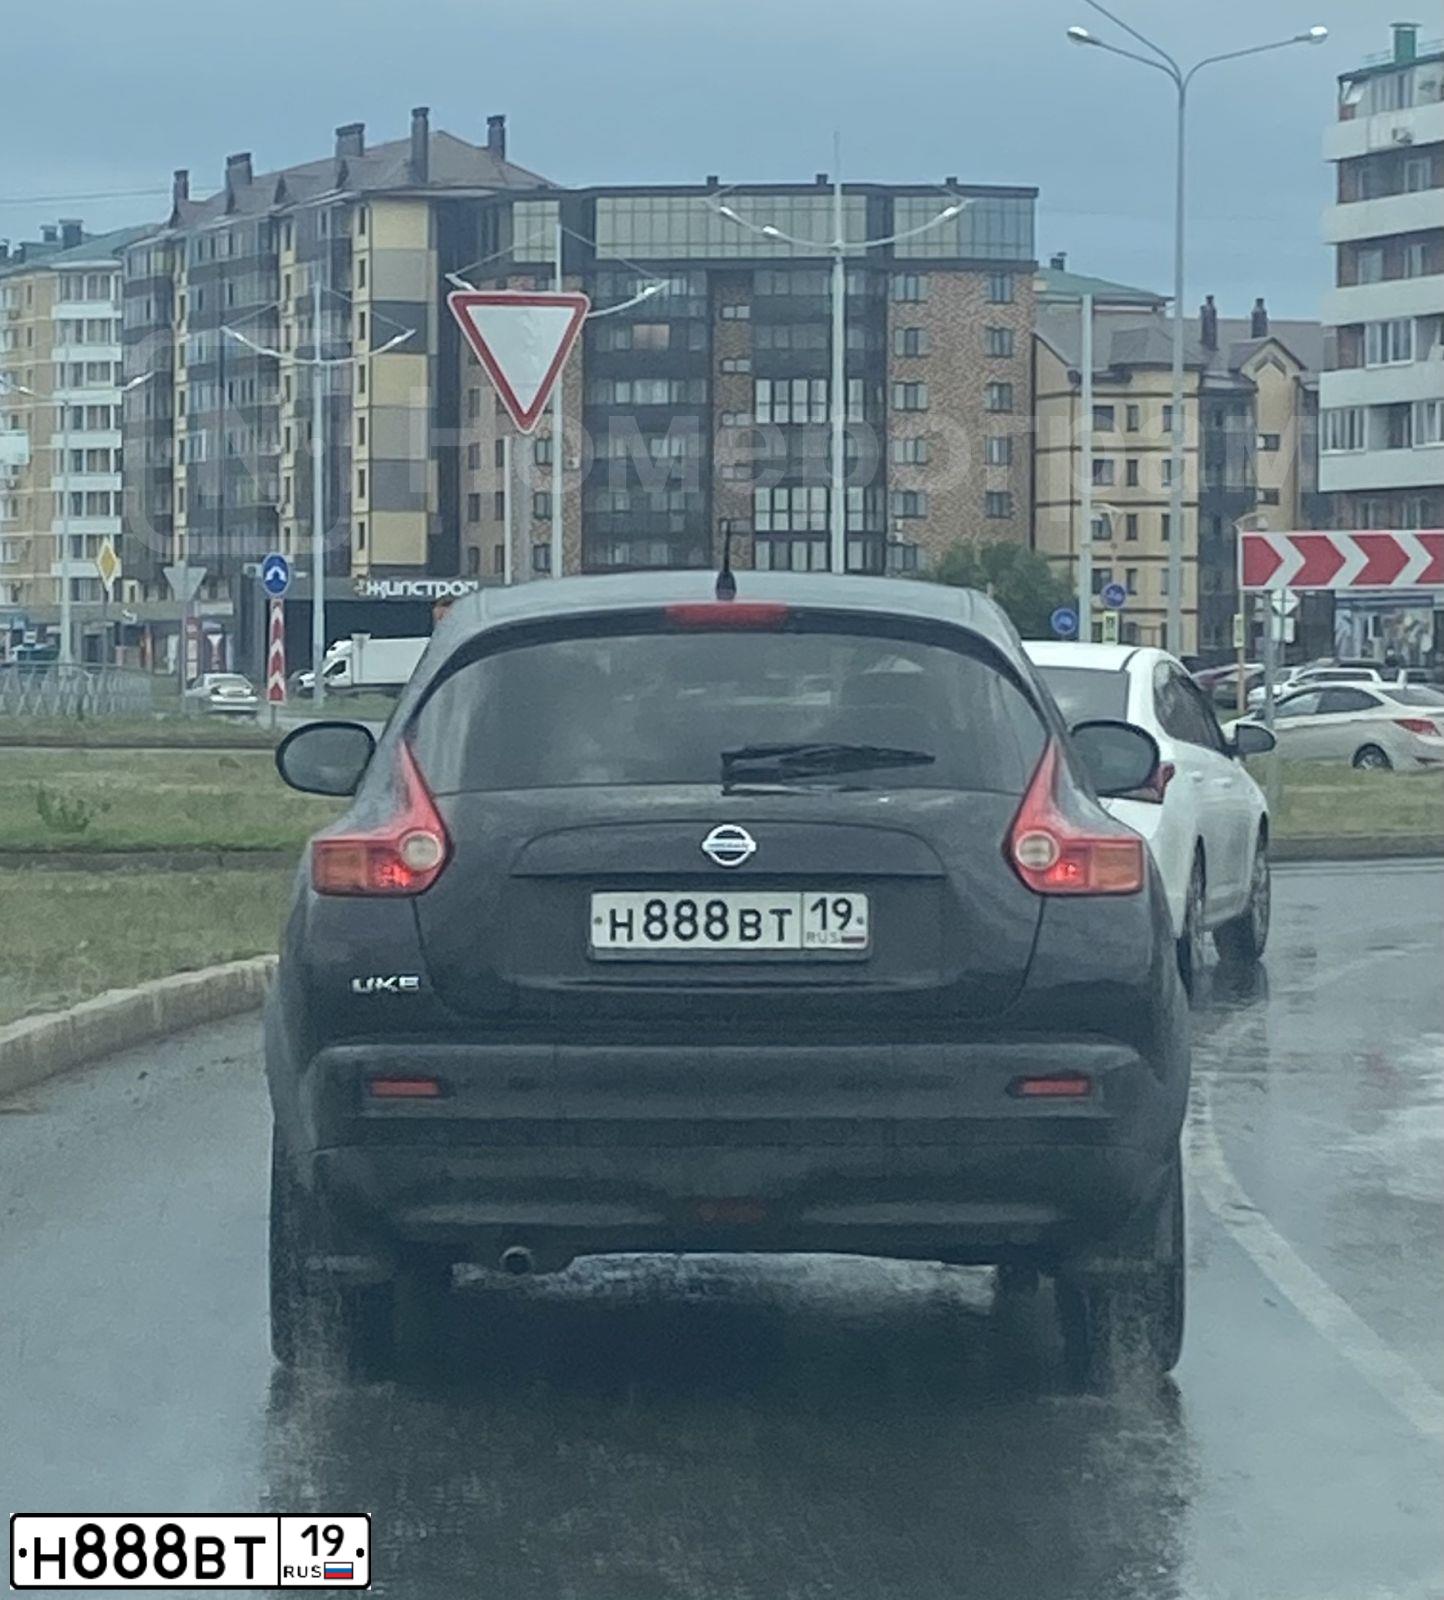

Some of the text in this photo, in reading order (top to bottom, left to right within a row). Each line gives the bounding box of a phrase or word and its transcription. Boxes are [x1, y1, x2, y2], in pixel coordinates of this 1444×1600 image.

[609, 897, 852, 942] Н888ВТ 19
[806, 931, 840, 943] RUS
